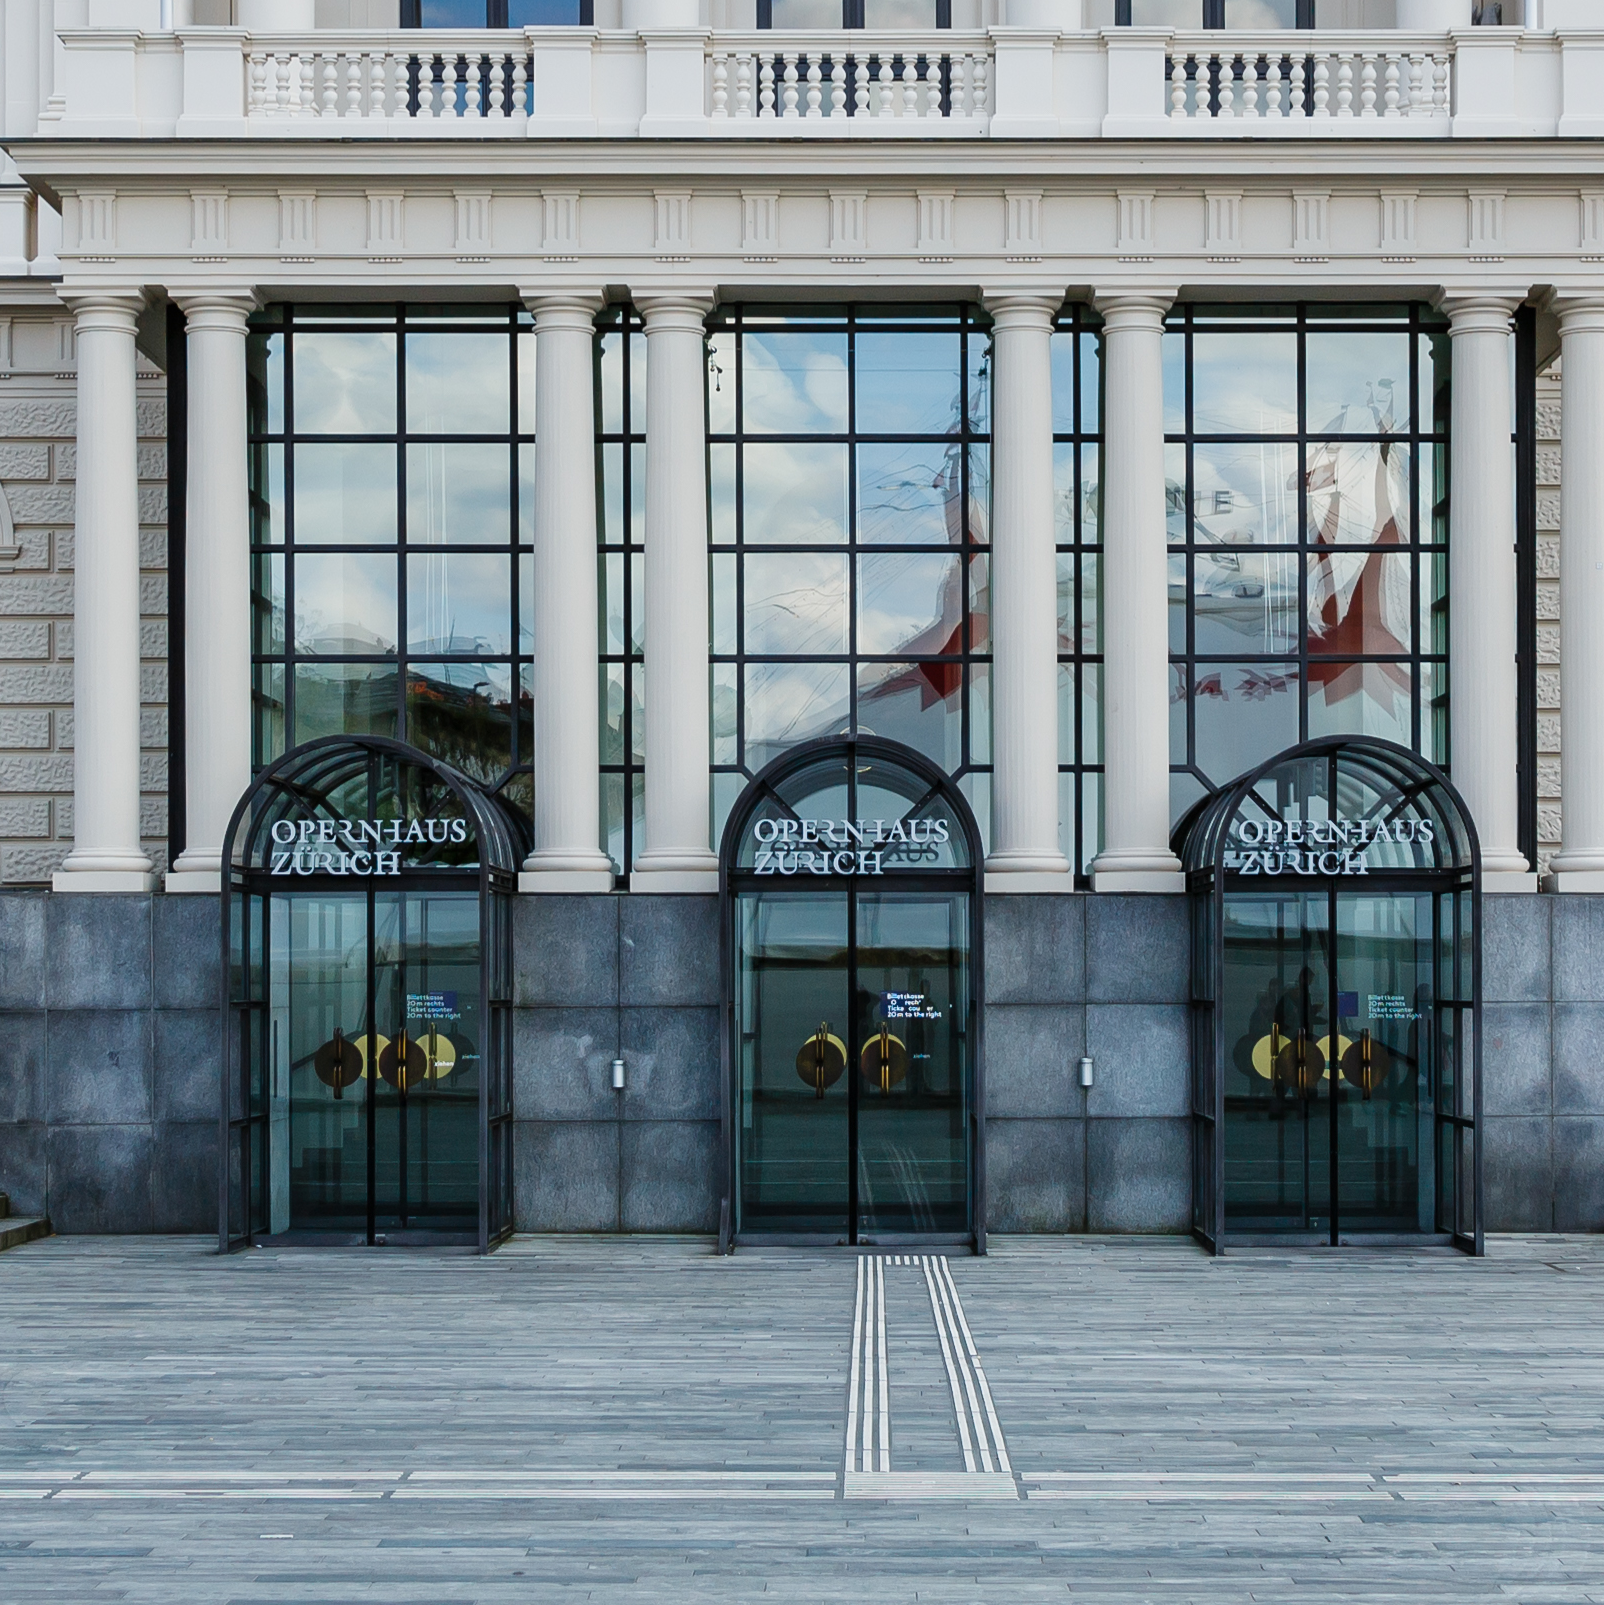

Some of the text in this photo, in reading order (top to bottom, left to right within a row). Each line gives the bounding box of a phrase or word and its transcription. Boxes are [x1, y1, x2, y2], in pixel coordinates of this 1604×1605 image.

[271, 818, 466, 844] OPERNHAUS
[754, 818, 949, 844] OPERNHAUS
[1239, 818, 1434, 844] OPERNHAUS
[271, 845, 401, 875] ZÜRICH
[754, 845, 883, 875] ZÜRICH
[1239, 845, 1368, 875] ZÜRICH
[445, 1012, 461, 1020] right
[925, 1011, 942, 1020] right
